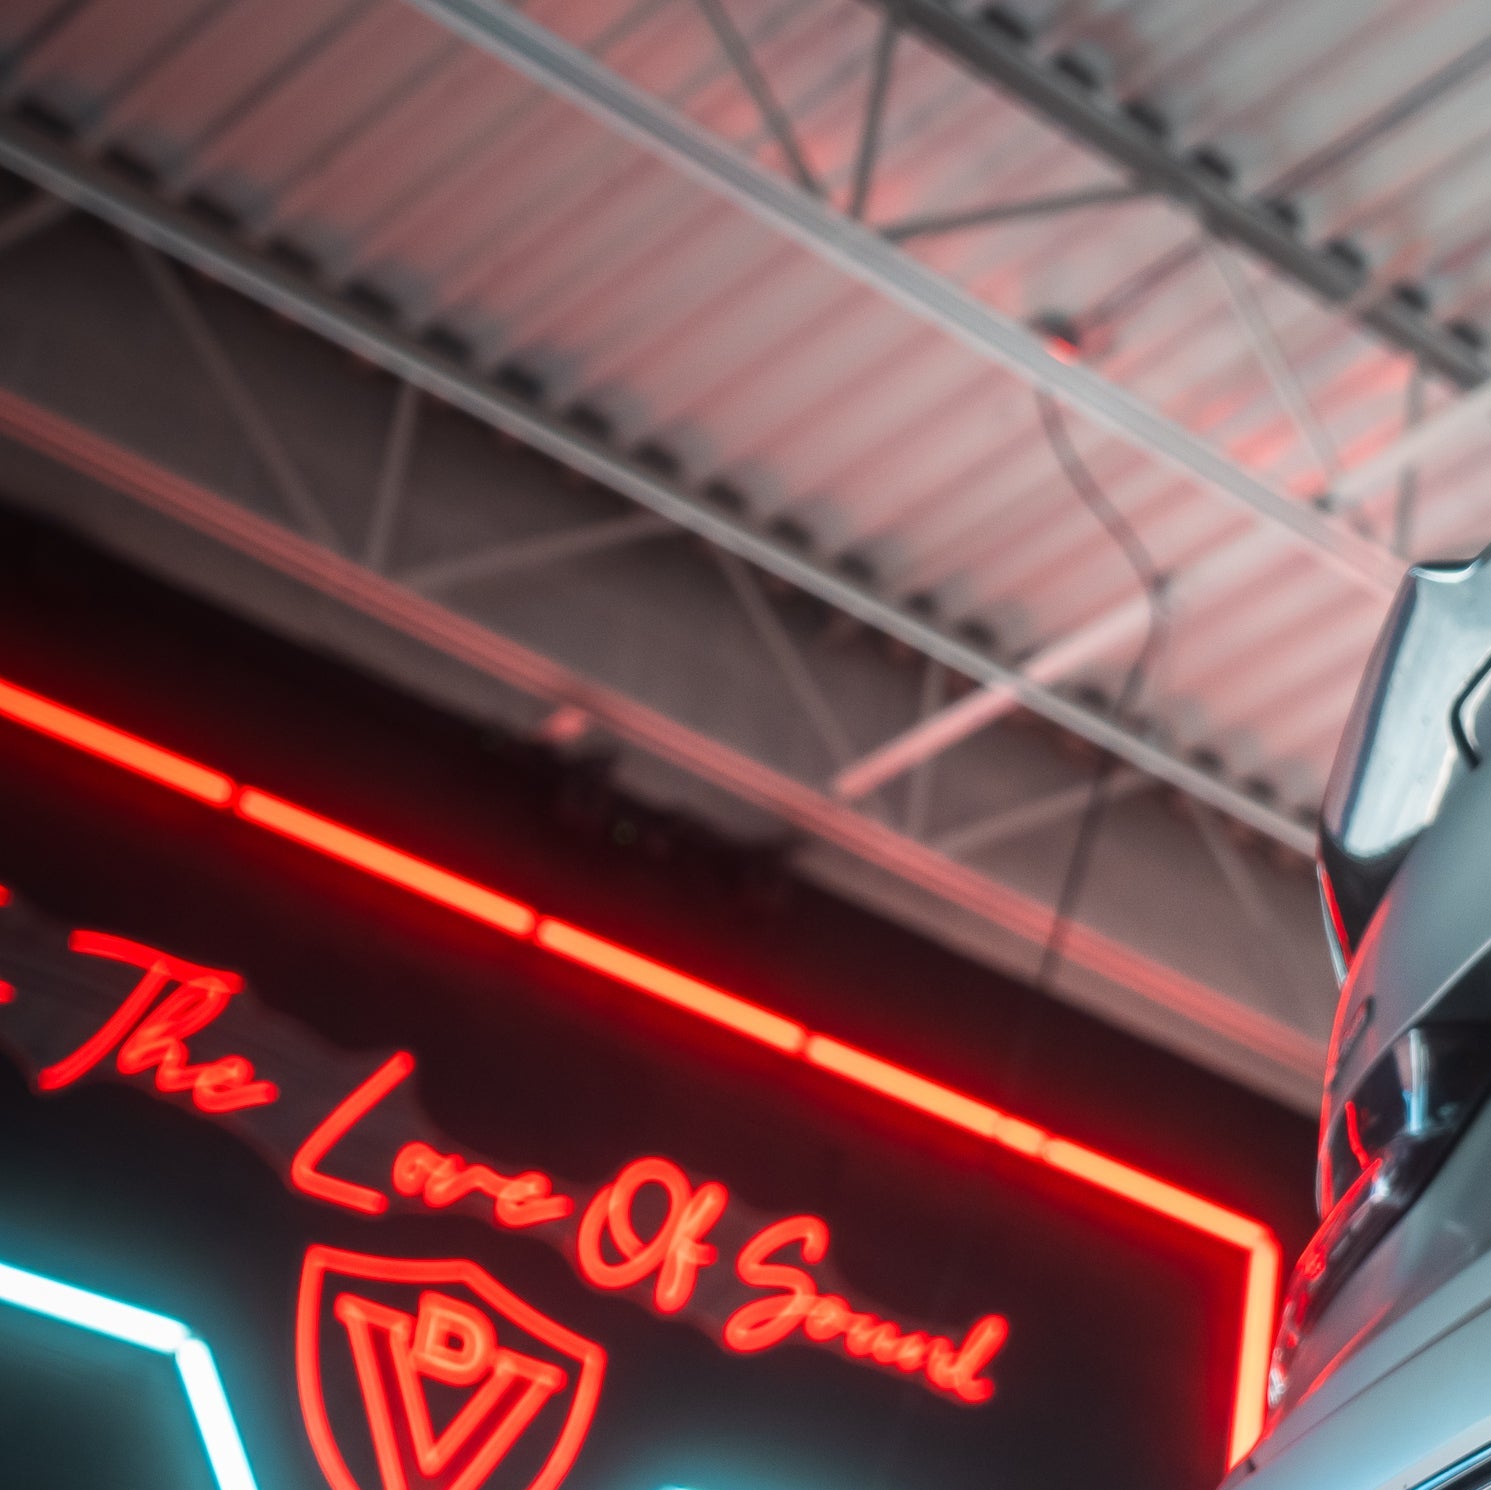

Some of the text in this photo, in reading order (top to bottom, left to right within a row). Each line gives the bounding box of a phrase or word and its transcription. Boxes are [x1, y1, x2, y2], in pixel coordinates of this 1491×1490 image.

[37, 929, 279, 1115] The
[288, 1050, 576, 1232] Love
[577, 1155, 731, 1316] Of
[722, 1213, 1012, 1407] Sound
